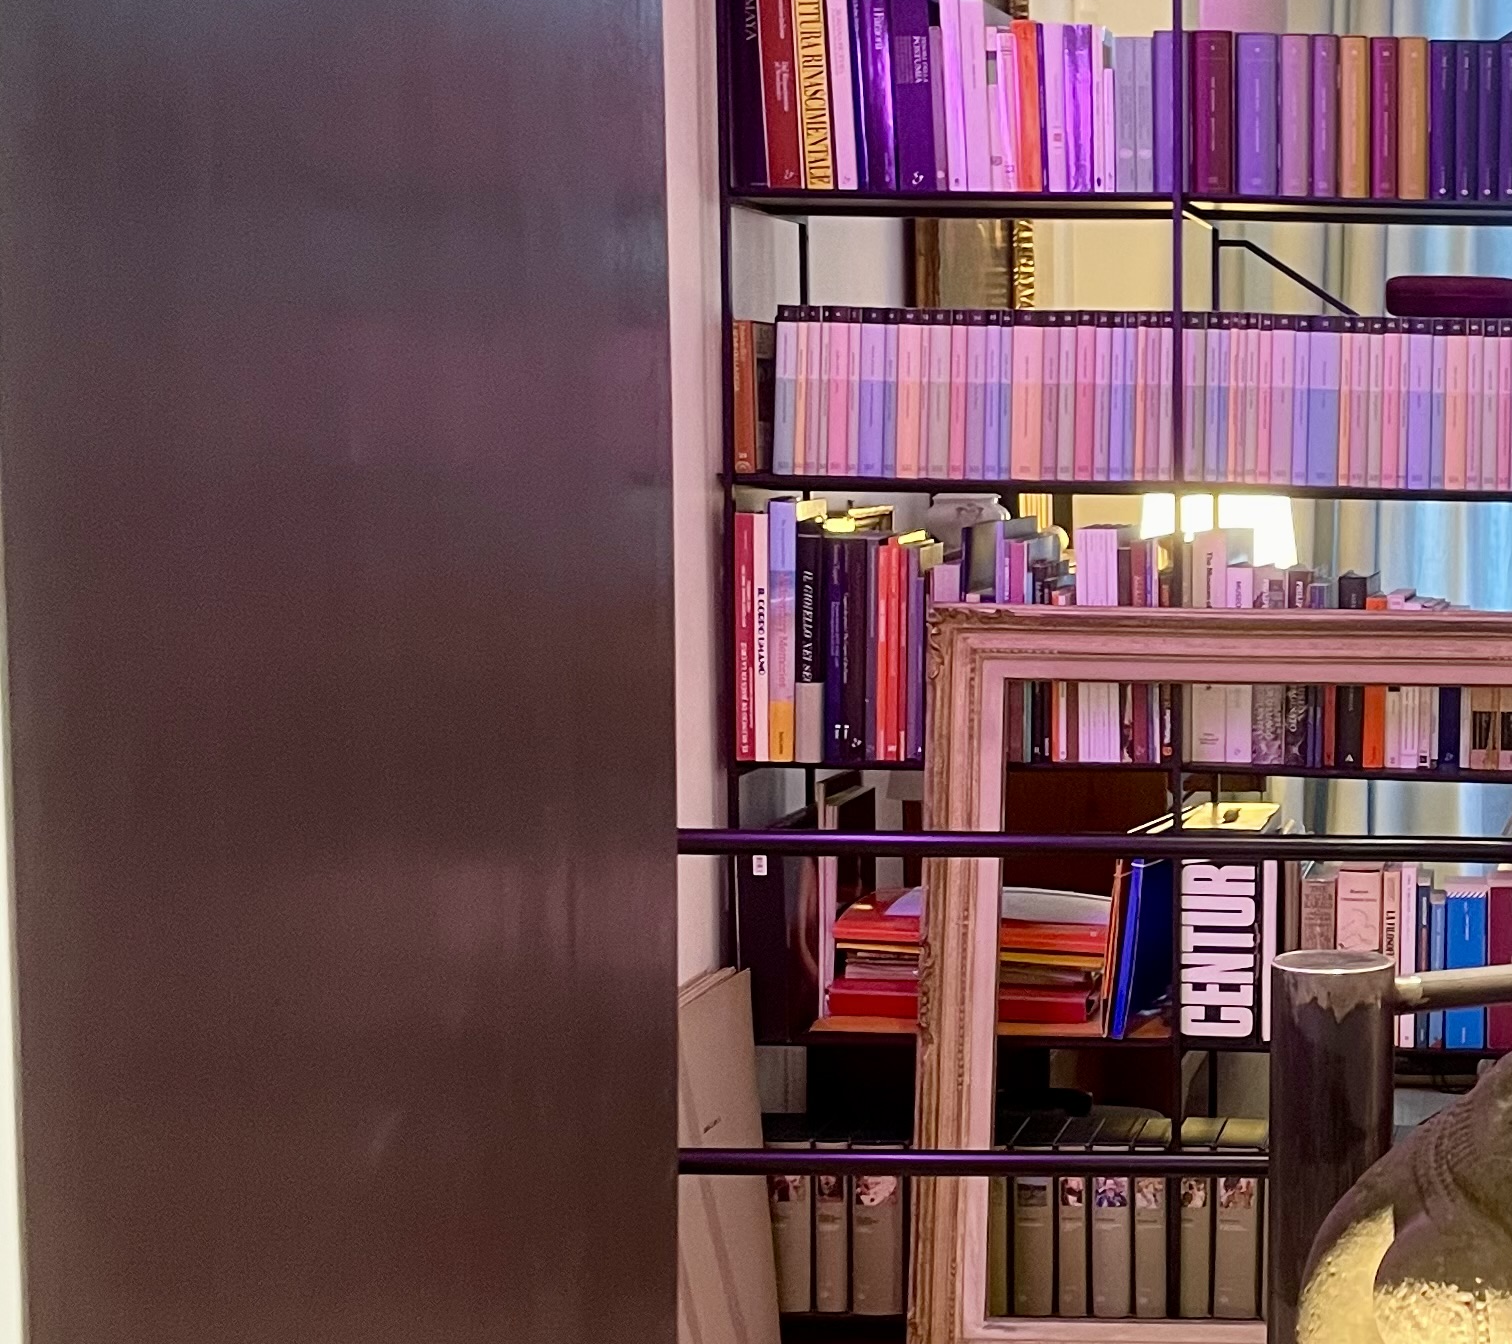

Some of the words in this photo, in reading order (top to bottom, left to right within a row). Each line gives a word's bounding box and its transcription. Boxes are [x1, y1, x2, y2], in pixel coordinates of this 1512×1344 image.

[801, 54, 834, 186] RINASCIMENTALE
[803, 570, 813, 583] IL
[757, 599, 765, 635] CORPO
[802, 584, 814, 638] GIOIELLO
[757, 637, 766, 676] UMANO
[1180, 859, 1256, 1038] CENTUR
